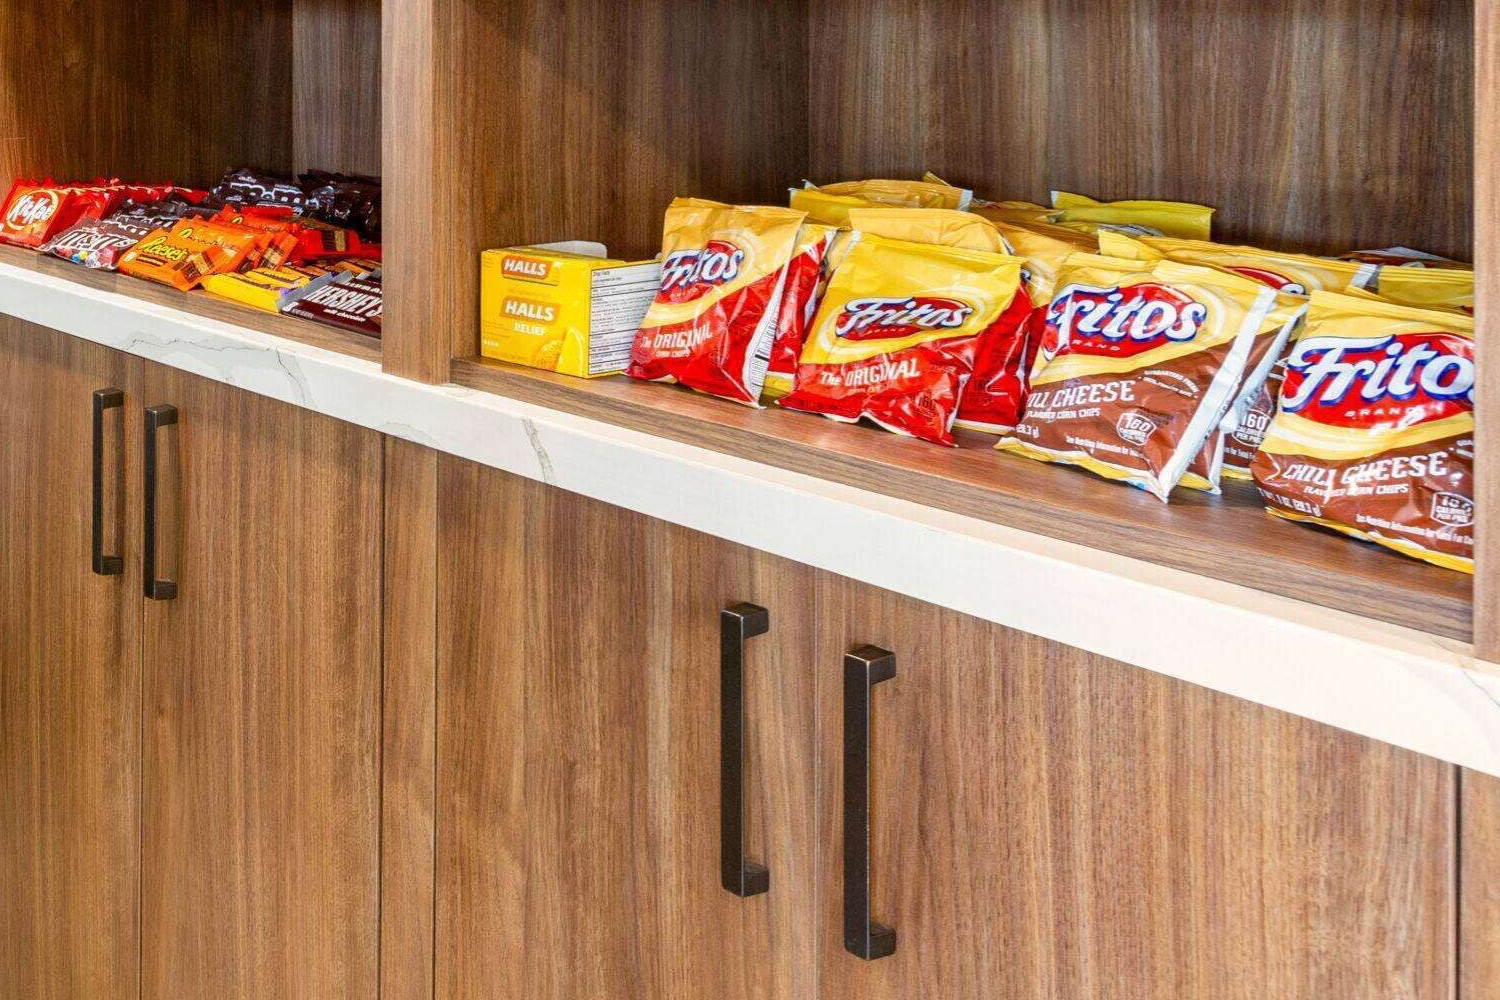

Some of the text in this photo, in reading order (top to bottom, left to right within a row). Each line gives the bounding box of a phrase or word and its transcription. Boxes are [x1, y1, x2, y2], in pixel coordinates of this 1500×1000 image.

[503, 259, 546, 276] HALLS
[660, 248, 745, 292] Fritos
[504, 300, 554, 321] HALLS
[835, 297, 974, 338] Fritos
[514, 322, 546, 336] RELIEF
[653, 323, 713, 348] ORIGINAL
[1072, 339, 1121, 351] RAND
[821, 358, 920, 387] The ORIGINAL
[1281, 335, 1474, 413] Frito
[1051, 380, 1136, 408] CHEESE
[1079, 408, 1100, 417] CHIPS
[1241, 413, 1268, 431] 160
[1125, 417, 1151, 432] 160
[1282, 451, 1449, 488] CHILI CHEESE
[1376, 483, 1409, 495] CHIPS
